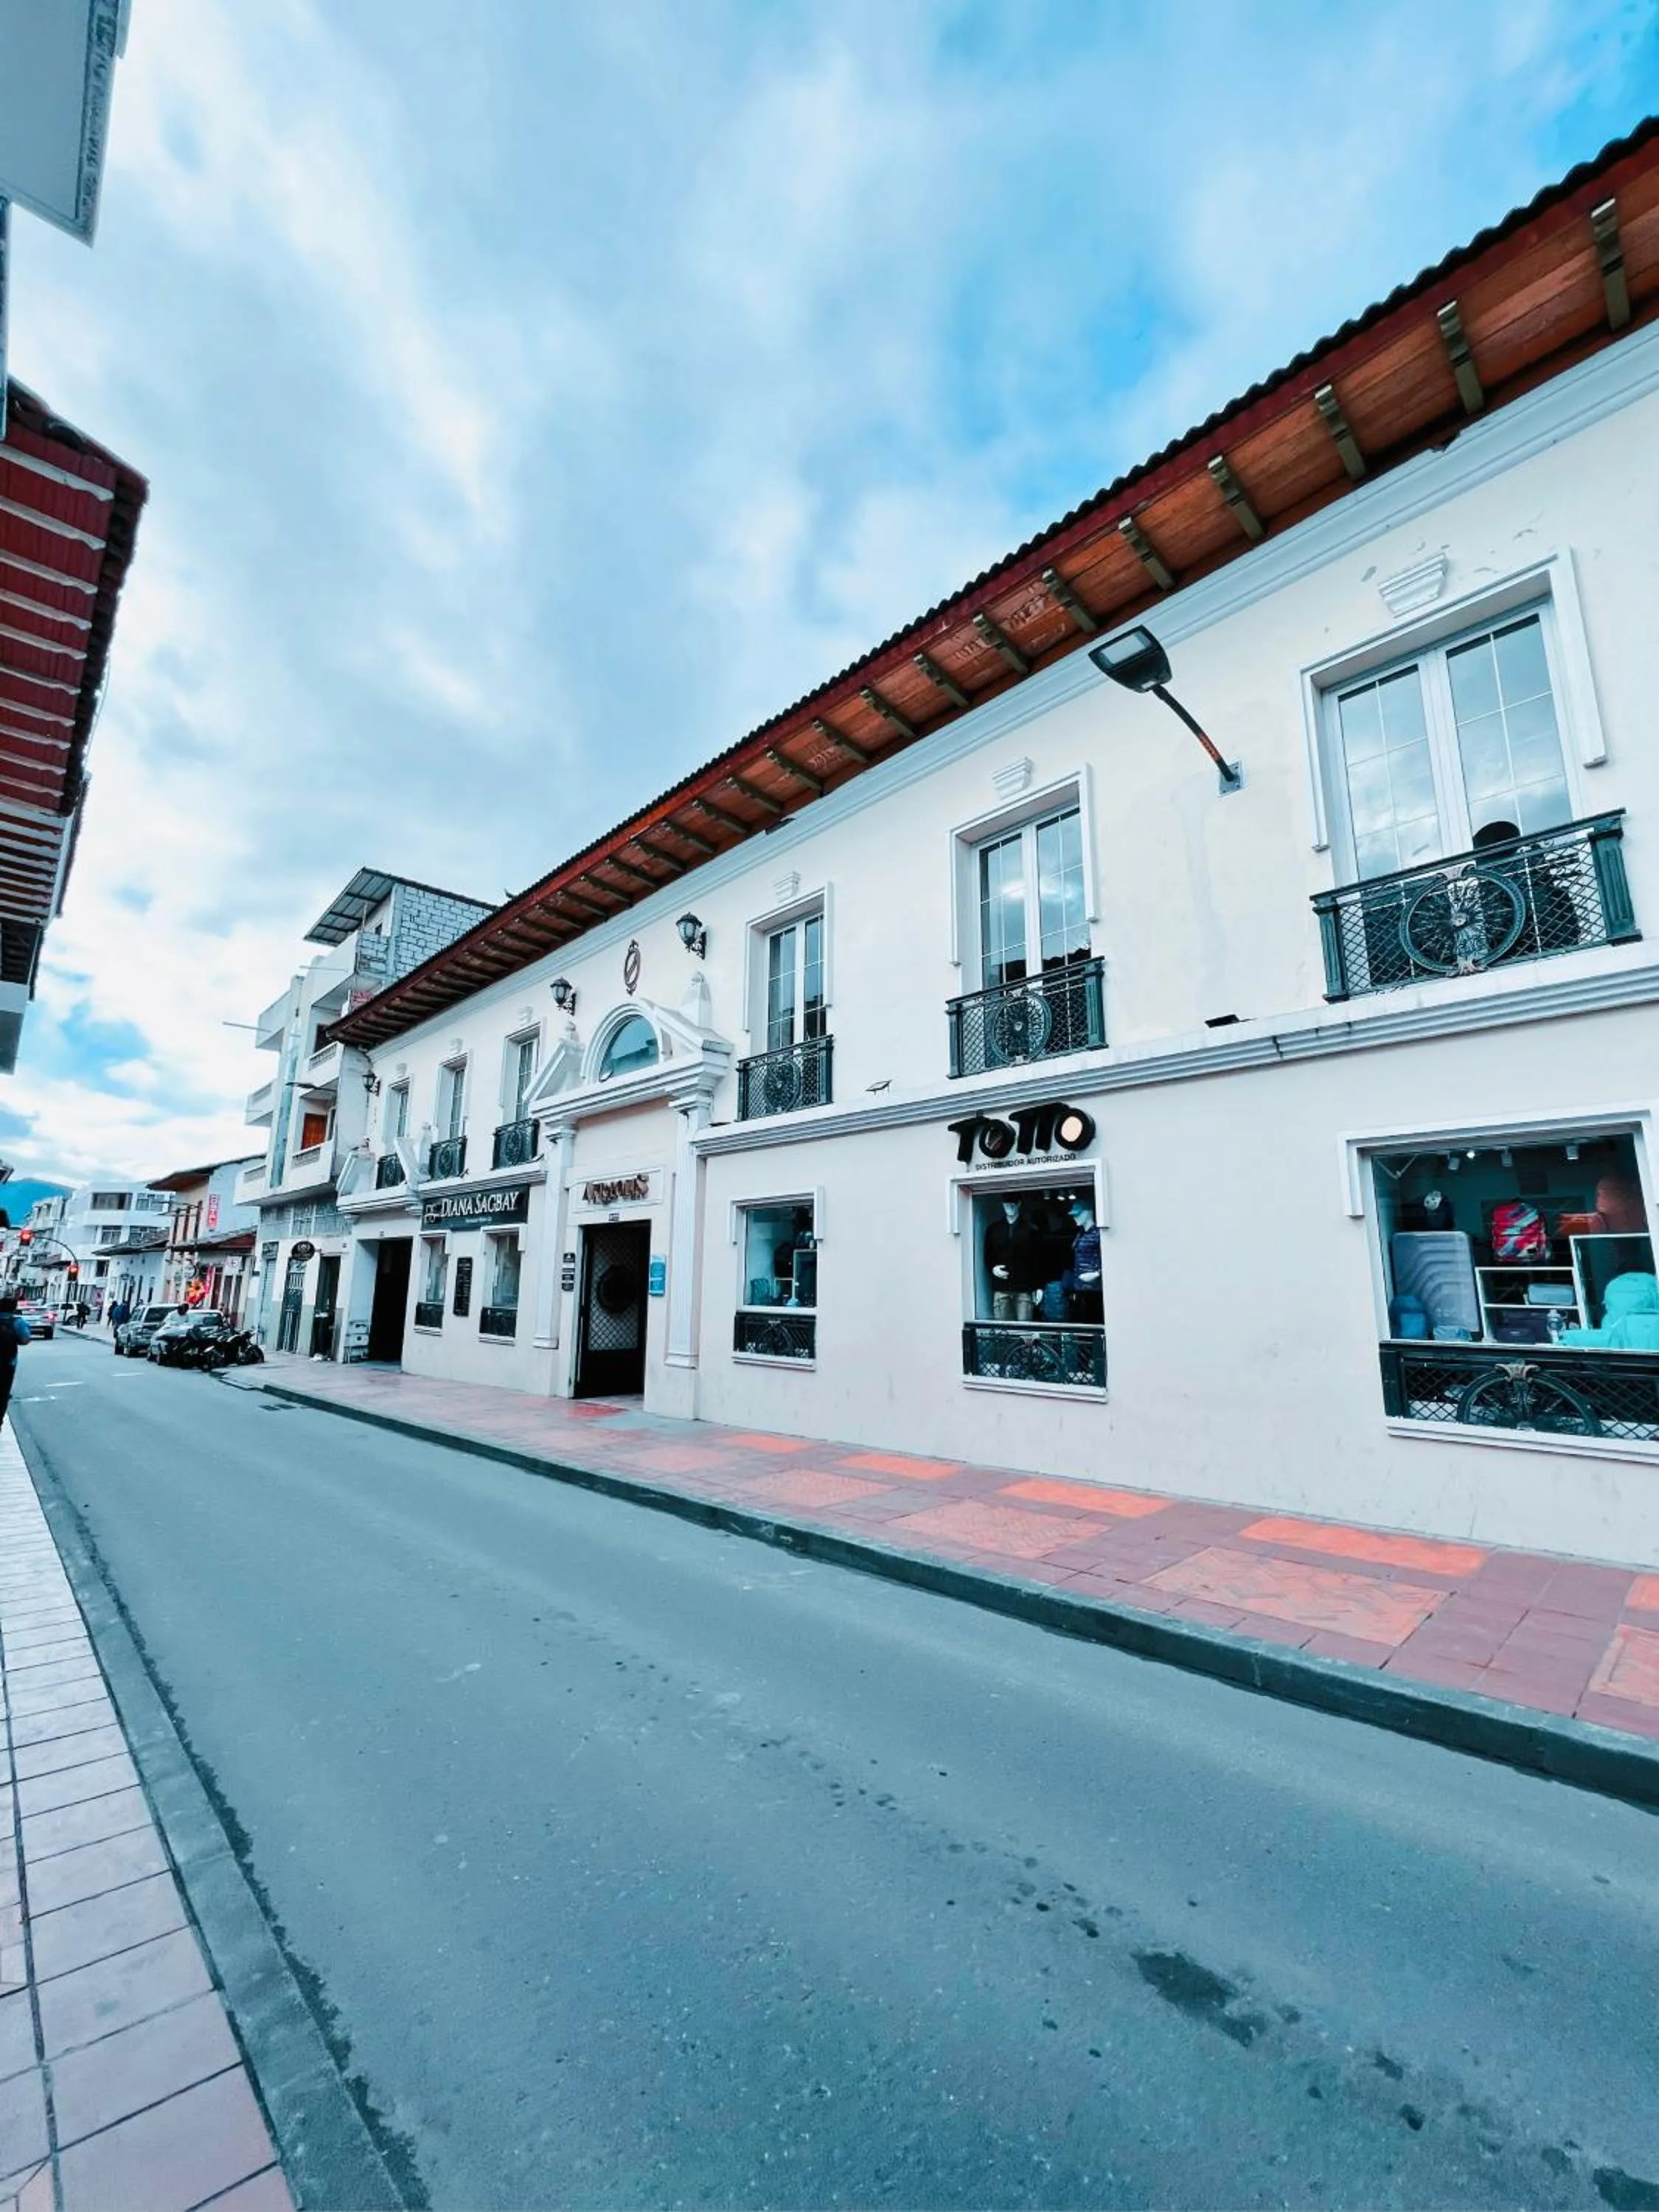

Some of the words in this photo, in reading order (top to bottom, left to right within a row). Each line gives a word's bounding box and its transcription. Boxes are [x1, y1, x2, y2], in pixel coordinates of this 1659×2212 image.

[947, 1102, 1096, 1164] TOTTO
[975, 1158, 1025, 1171] DISTRIBUIDOR
[1026, 1153, 1076, 1166] AUTORIZADO
[440, 1198, 473, 1217] DIANA
